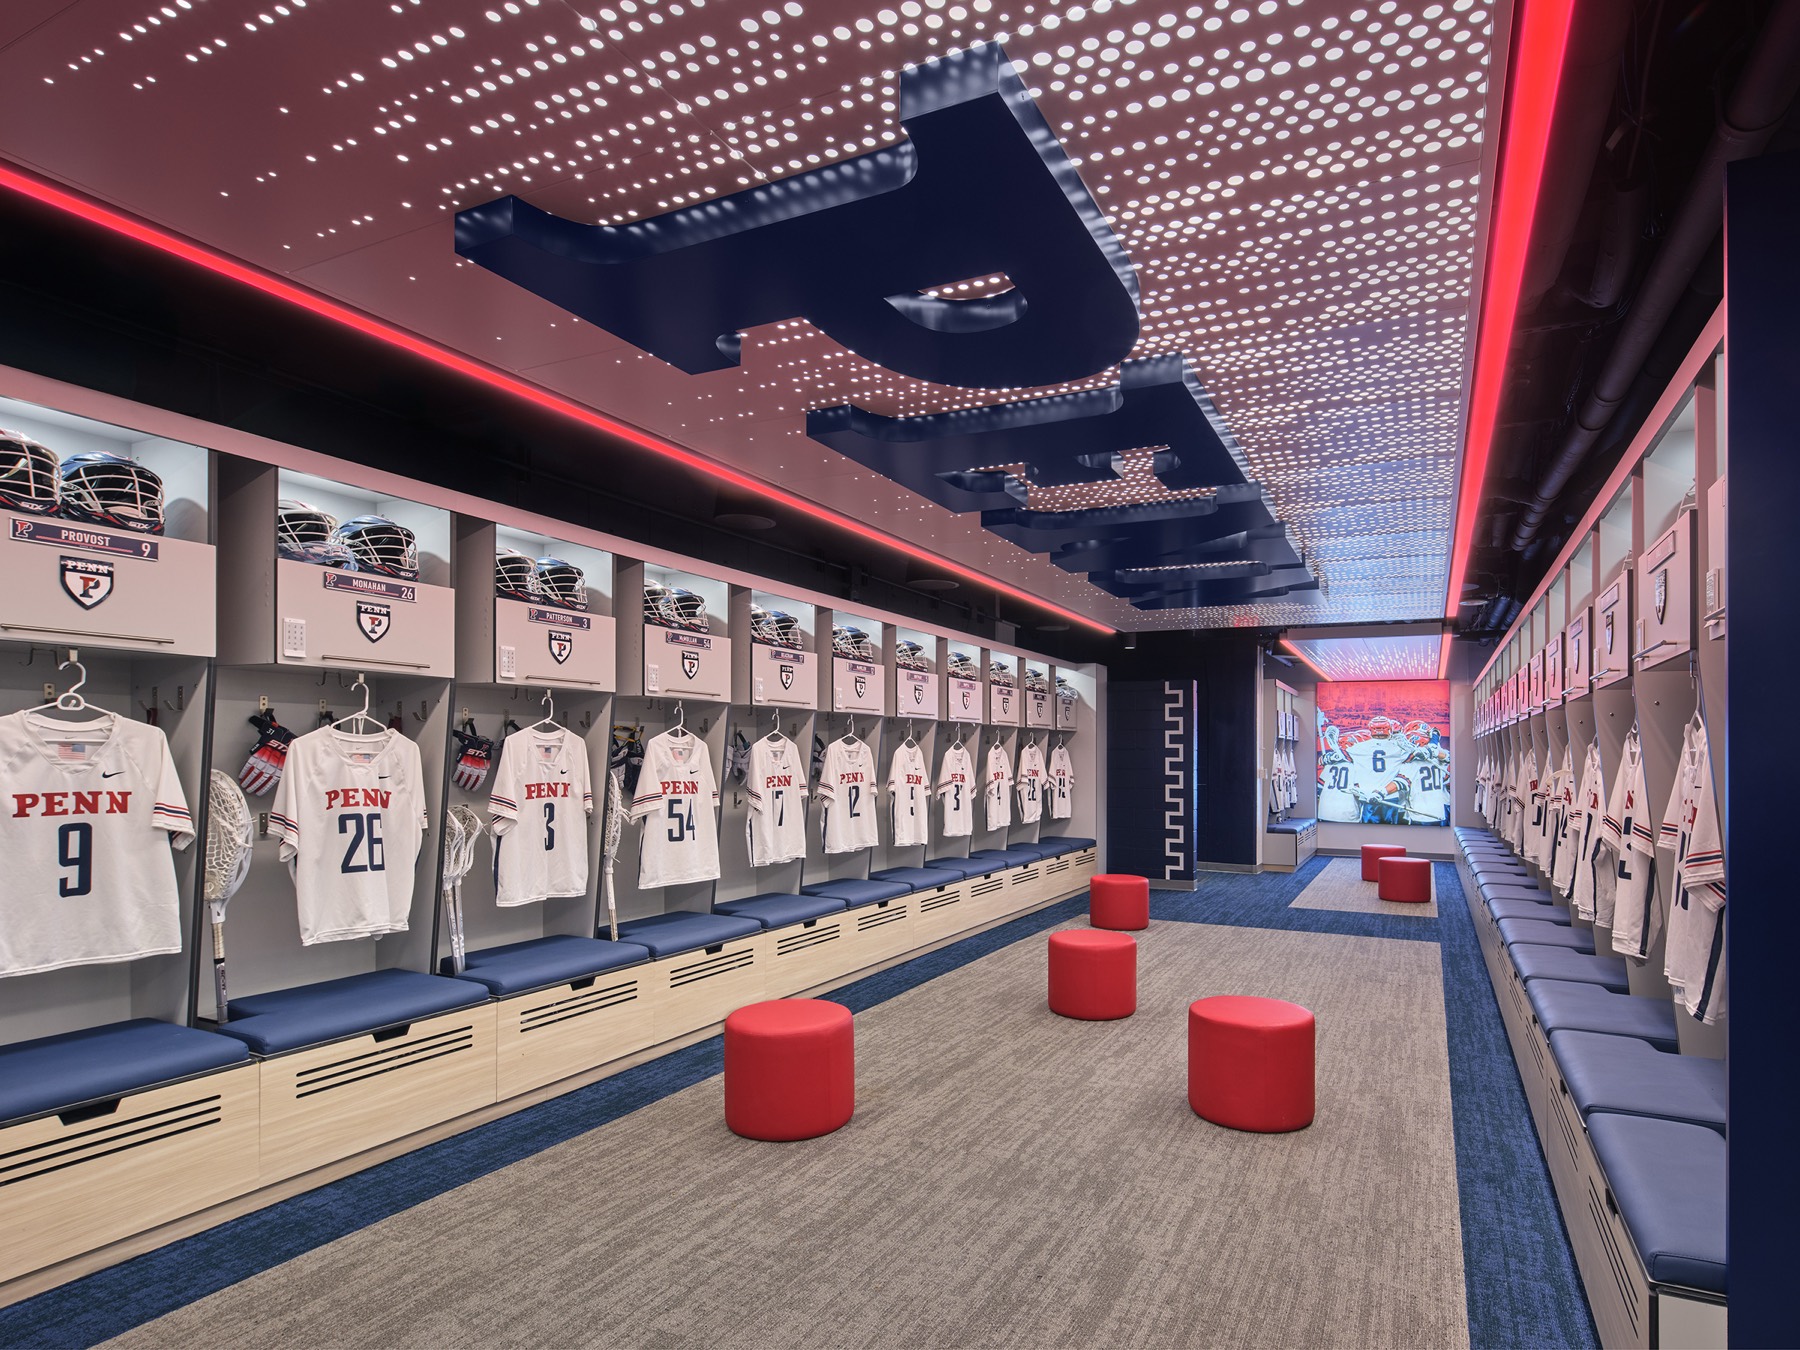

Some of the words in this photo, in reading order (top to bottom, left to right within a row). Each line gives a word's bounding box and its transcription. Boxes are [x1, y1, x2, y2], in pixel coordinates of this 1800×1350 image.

[20, 501, 46, 511] STX
[128, 520, 150, 530] STX
[61, 529, 111, 547] PROVOST
[141, 543, 151, 557] 9
[65, 560, 110, 574] PENN
[79, 575, 101, 598] P
[352, 579, 386, 592] MONAHAN
[401, 587, 413, 600] 26
[360, 604, 388, 615] PENN
[546, 612, 573, 623] PATTERSON
[582, 618, 588, 628] 3
[368, 616, 382, 634] P
[551, 632, 571, 641] PENN
[703, 639, 710, 648] 54
[556, 642, 566, 657] P
[466, 748, 487, 757] STX
[1372, 749, 1386, 772] 6
[660, 781, 699, 795] PENN
[766, 775, 792, 788] PENN
[1327, 766, 1349, 789] 30
[1419, 765, 1441, 791] 20
[12, 790, 133, 818] PENN
[325, 788, 392, 810] PENN
[848, 785, 860, 819] 12
[543, 802, 555, 851] 3
[667, 798, 696, 842] 54
[338, 813, 385, 873] 26
[58, 822, 92, 898] 9
